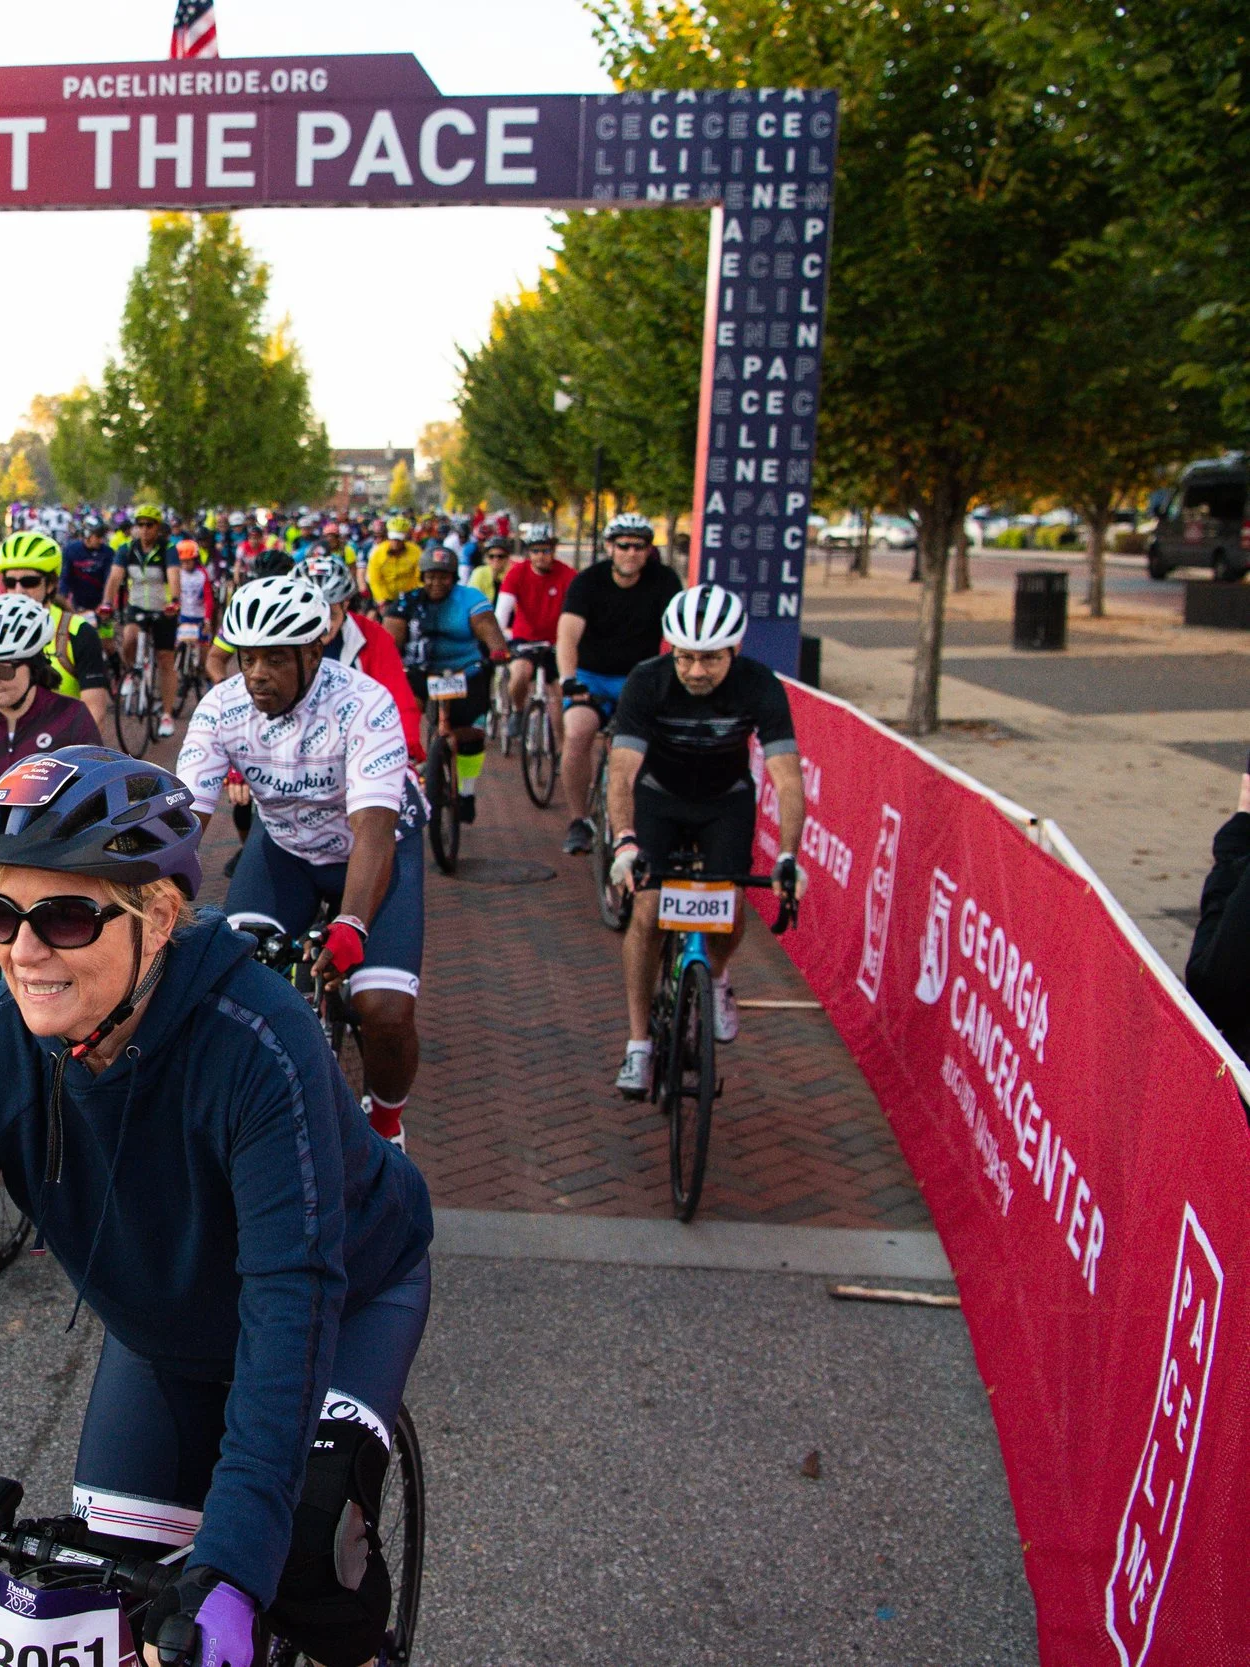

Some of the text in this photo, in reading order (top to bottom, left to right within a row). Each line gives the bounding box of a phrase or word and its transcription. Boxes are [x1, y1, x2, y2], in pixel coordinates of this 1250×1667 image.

[62, 69, 328, 99] PACELINERIDE.ORG
[78, 113, 256, 190] THE
[296, 108, 540, 187] PACE
[663, 897, 730, 917] PL2081
[959, 898, 1048, 1064] GEORGIA
[950, 976, 1105, 1295] CANCER CENTER
[311, 1440, 335, 1448] ER
[7, 1580, 37, 1600] PaceDay
[4, 1593, 37, 1617] 2022
